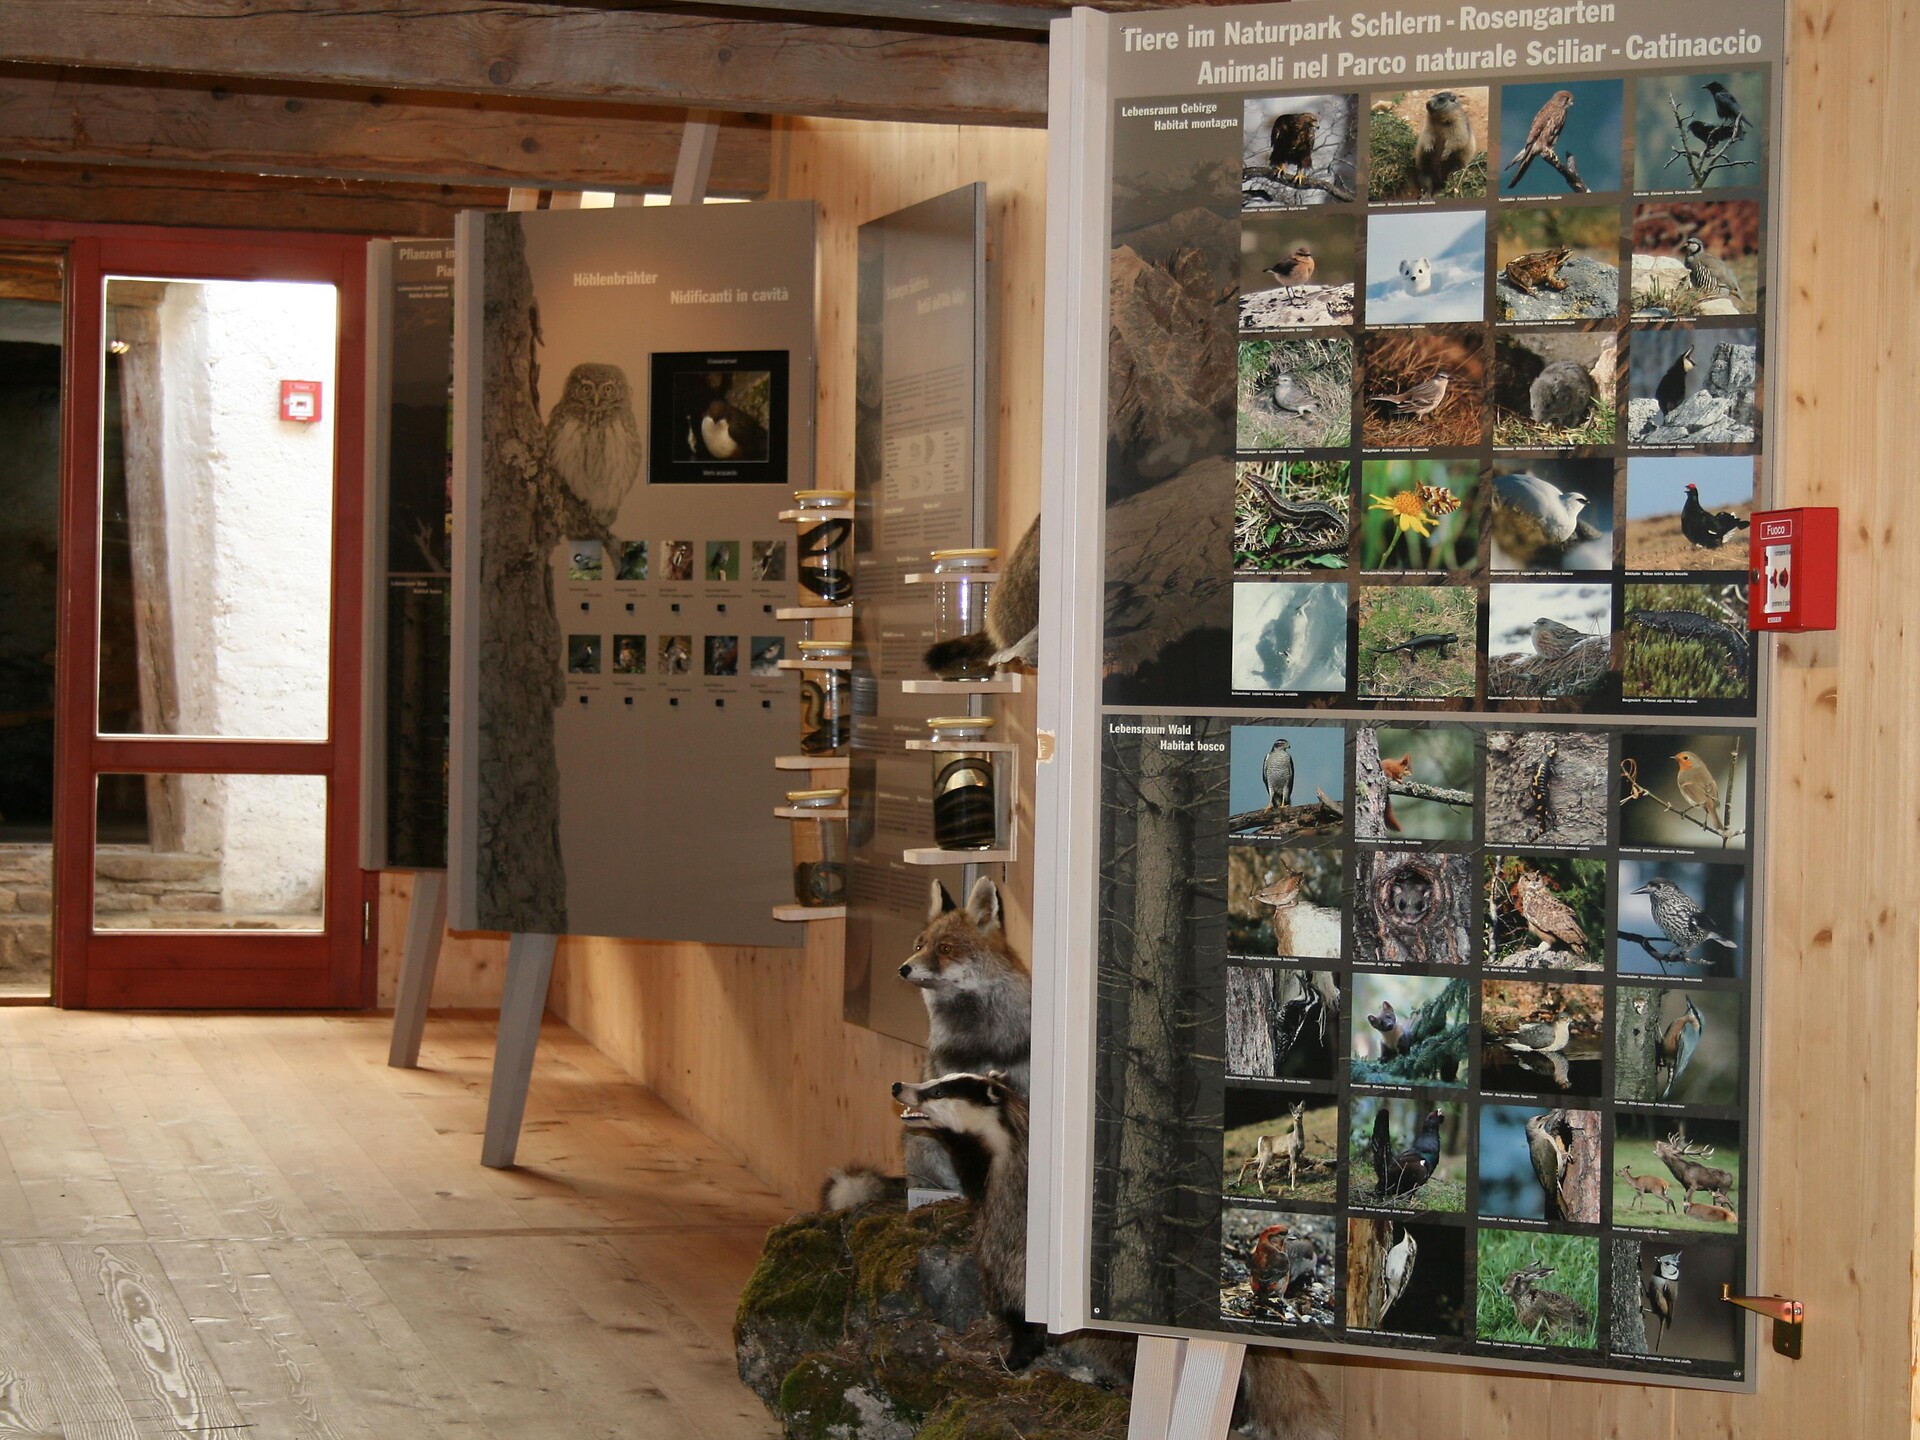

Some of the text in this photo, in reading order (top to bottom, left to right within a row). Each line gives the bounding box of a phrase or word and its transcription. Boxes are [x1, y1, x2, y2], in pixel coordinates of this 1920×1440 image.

[1122, 27, 1179, 52] Tiere
[1188, 24, 1215, 48] im
[1224, 15, 1342, 47] Naturpark
[1197, 57, 1283, 85] Animali
[1293, 54, 1328, 79] nel
[1338, 52, 1406, 77] Parco
[1416, 43, 1517, 72] naturale
[1122, 103, 1218, 117] Lebensraum Gebirge
[1154, 118, 1238, 130] Habitat montagna
[399, 248, 442, 261] Pflanzen
[573, 271, 658, 287] Höhlenbrühter
[670, 286, 789, 304] Nidificanti in cavità
[1767, 525, 1785, 536] Fuoco
[1109, 723, 1192, 735] Lebensraum Wald
[1160, 740, 1225, 752] Habitat bosco
